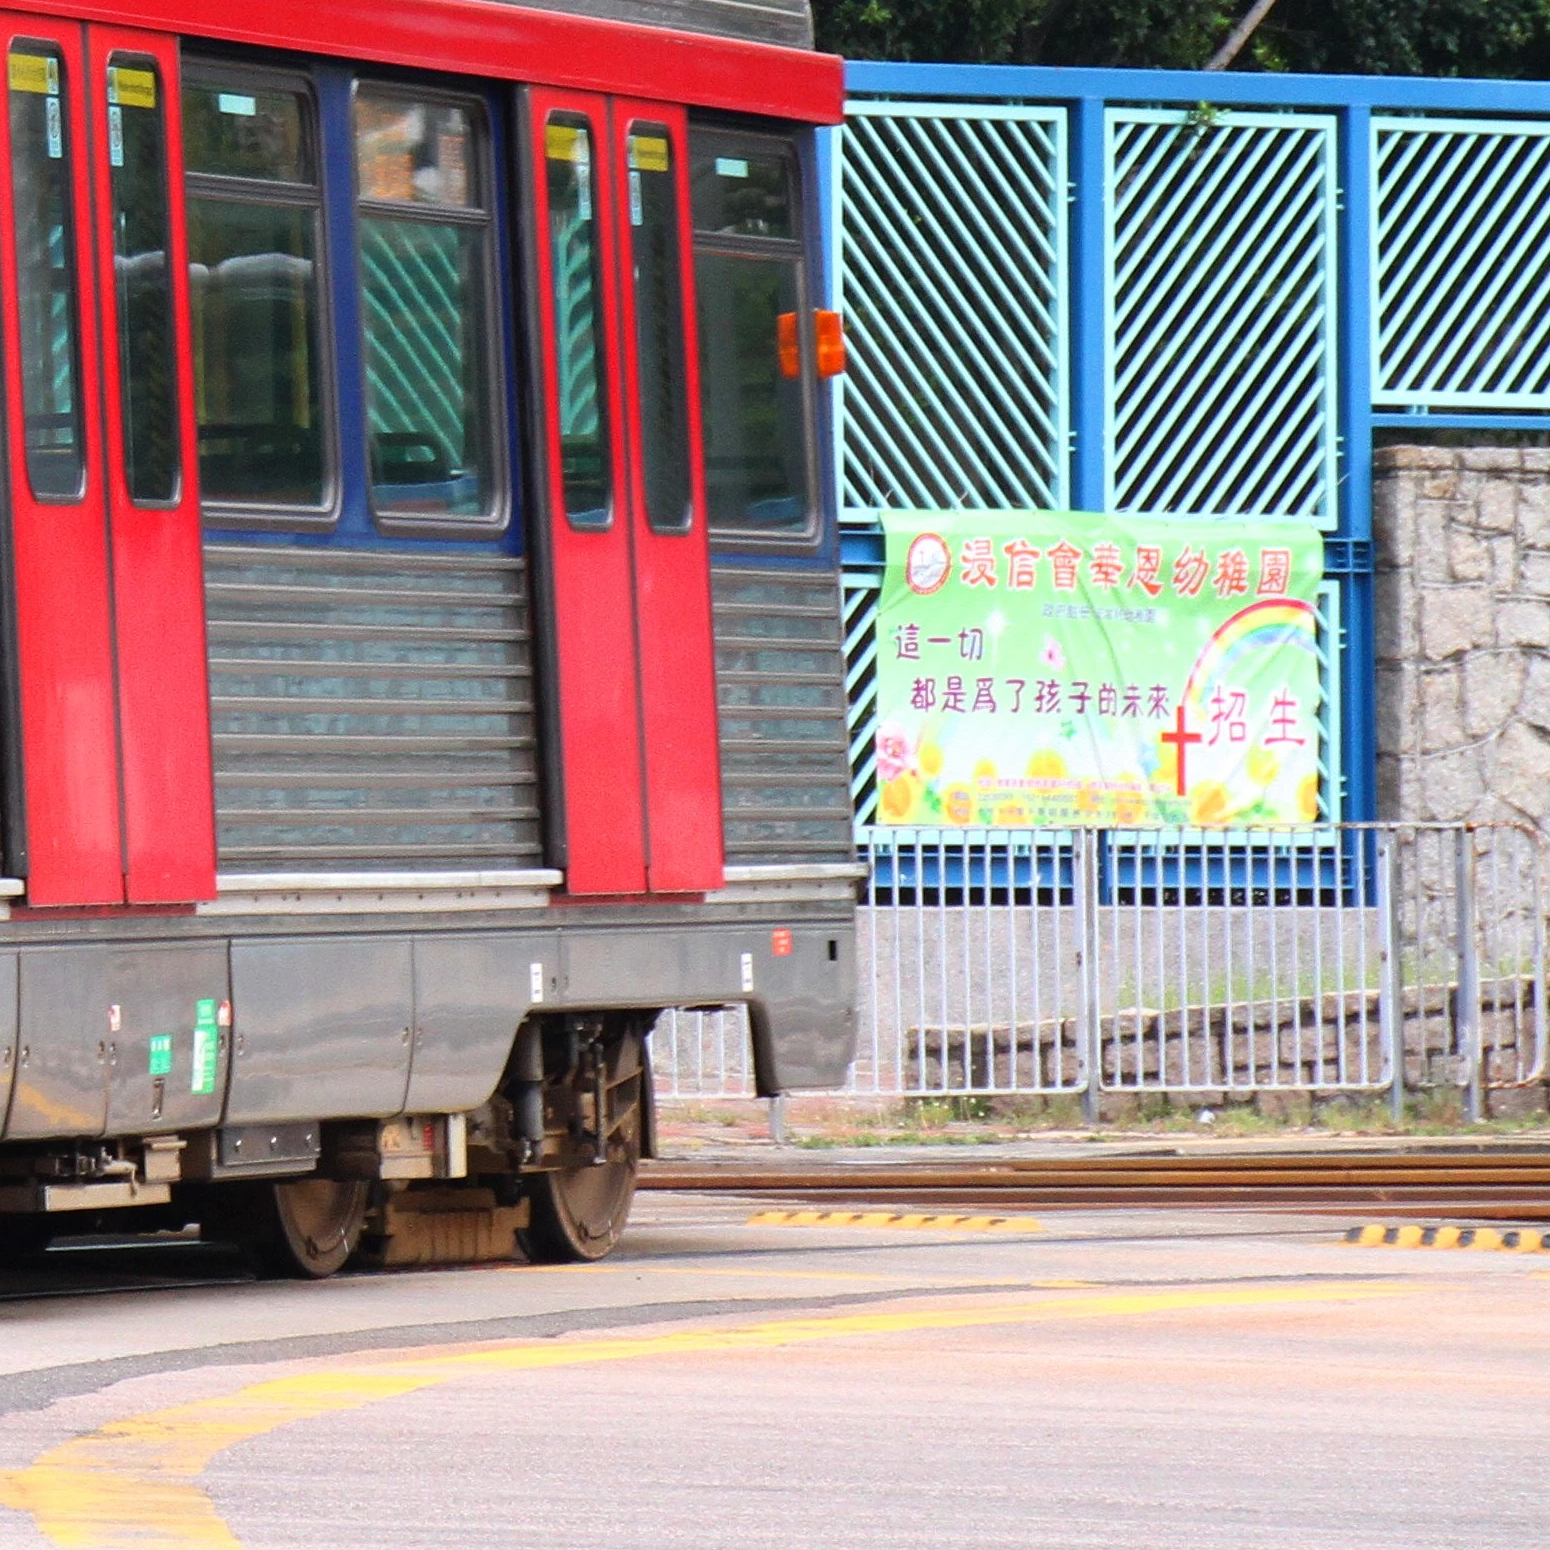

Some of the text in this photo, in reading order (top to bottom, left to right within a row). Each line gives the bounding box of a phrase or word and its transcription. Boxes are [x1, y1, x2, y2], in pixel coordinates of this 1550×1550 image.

[894, 622, 985, 661] 這一切
[1206, 685, 1307, 748] 招生
